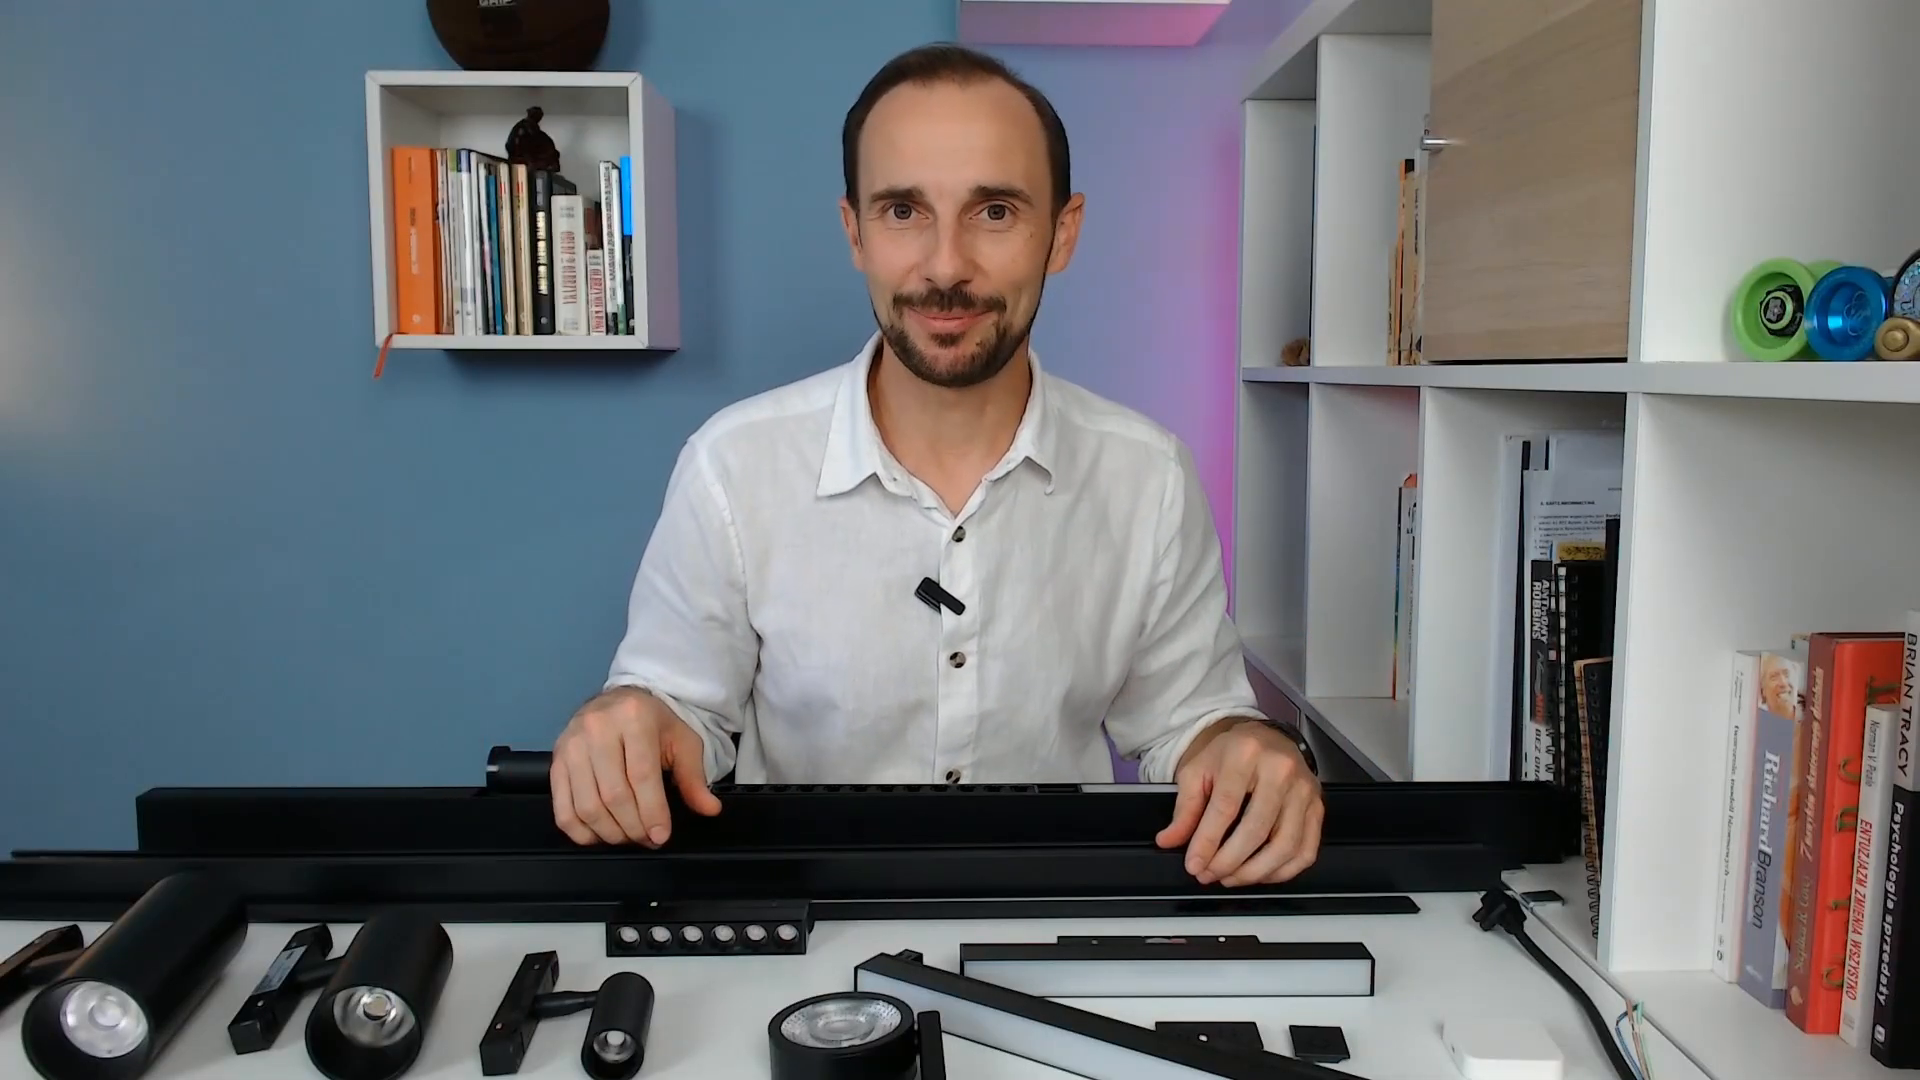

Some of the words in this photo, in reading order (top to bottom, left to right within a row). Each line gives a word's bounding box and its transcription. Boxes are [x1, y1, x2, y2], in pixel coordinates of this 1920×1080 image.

[1532, 581, 1542, 641] ROBBINS
[1903, 632, 1918, 700] BRIAN
[1867, 719, 1880, 758] Norman
[1897, 706, 1913, 778] TRACY
[1800, 841, 1813, 863] 7
[1853, 819, 1873, 887] ENTUZJAZM
[1884, 801, 1905, 911] Psychologia
[1850, 886, 1867, 940] ZMIENIA
[1845, 940, 1863, 1001] WSZYSTKO
[1875, 914, 1894, 1006] sprzedaży
